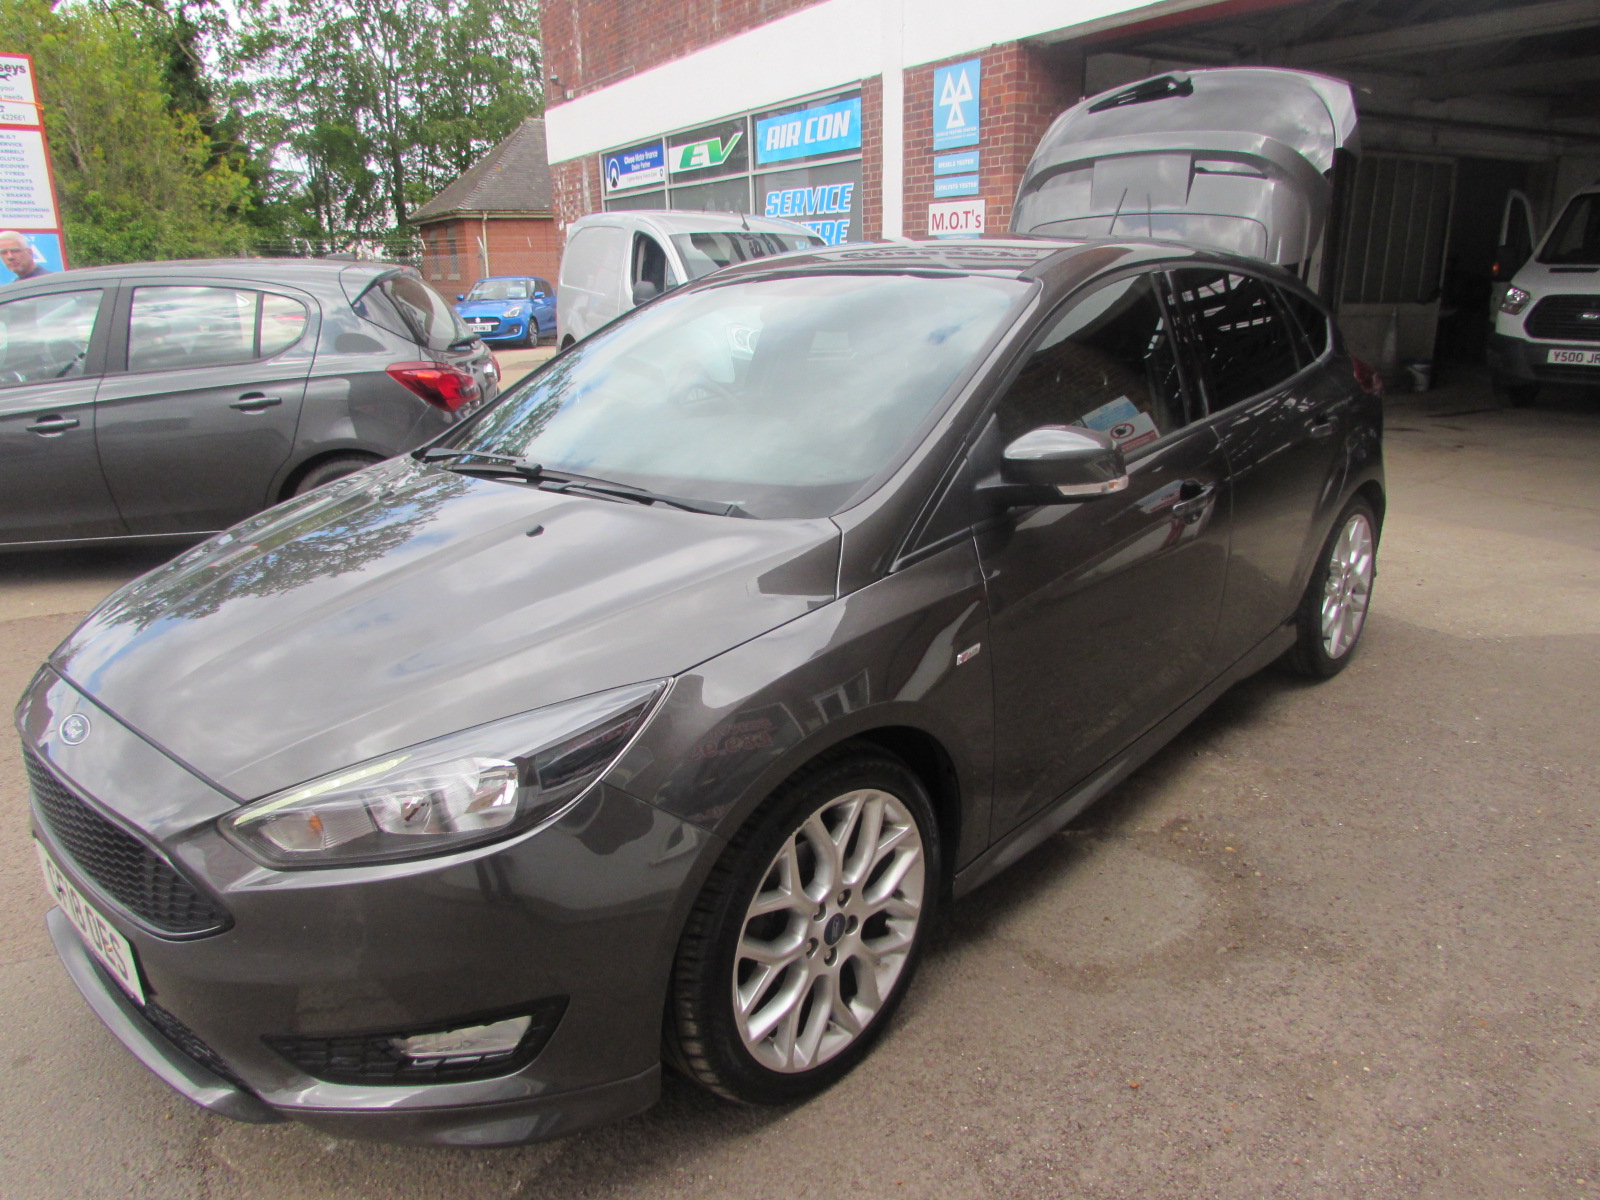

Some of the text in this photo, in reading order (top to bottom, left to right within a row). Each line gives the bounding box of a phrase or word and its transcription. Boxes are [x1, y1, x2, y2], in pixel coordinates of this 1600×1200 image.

[766, 110, 851, 151] AIR CON
[680, 133, 743, 168] EV
[765, 182, 855, 217] SERVICE
[931, 209, 982, 231] M.O.T's
[1553, 351, 1584, 363] Y500
[85, 905, 129, 980] OES
